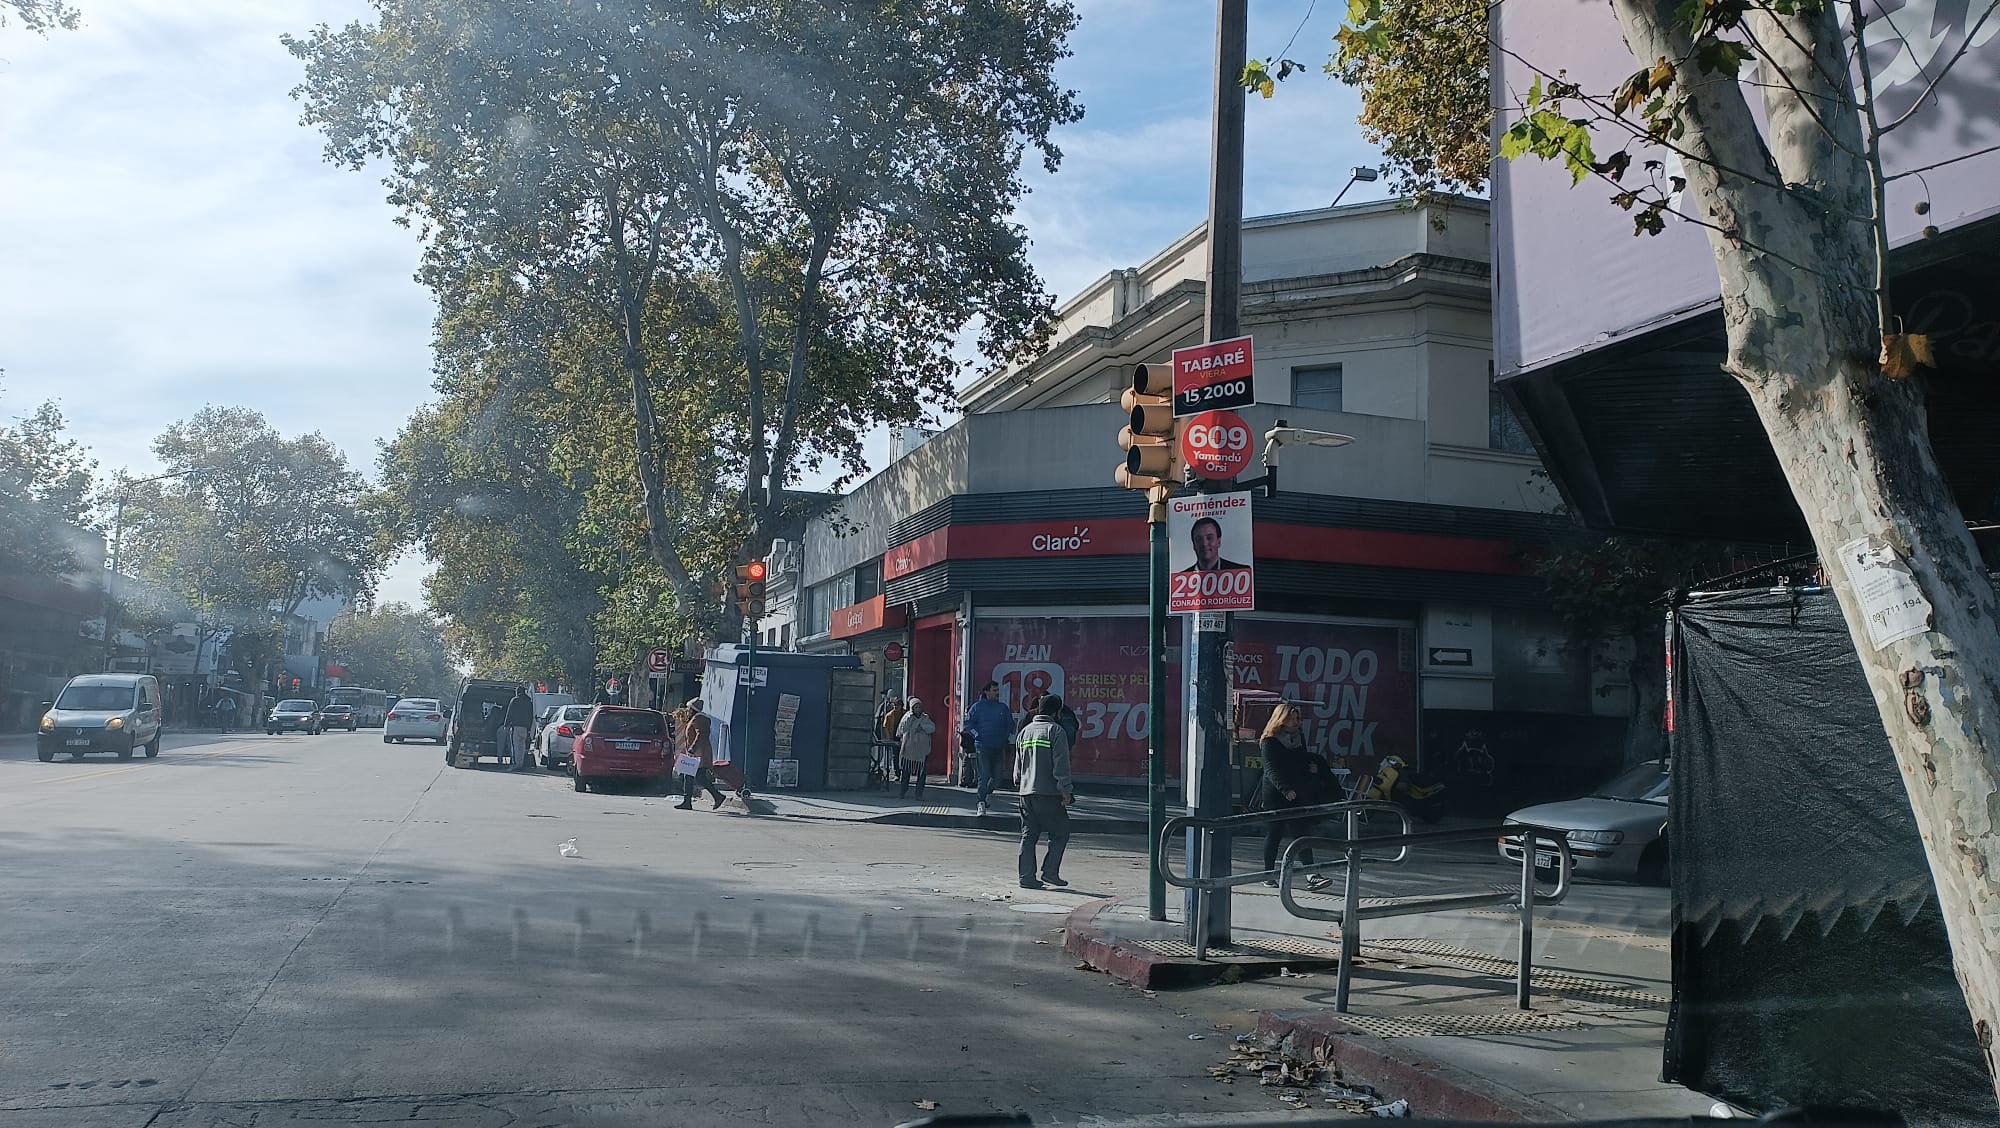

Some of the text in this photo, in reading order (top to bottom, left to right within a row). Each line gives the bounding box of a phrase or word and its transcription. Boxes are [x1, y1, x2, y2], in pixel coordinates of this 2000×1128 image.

[1182, 348, 1245, 373] TABARÉ
[1200, 368, 1226, 379] VIERA
[1183, 380, 1246, 403] 15 2000
[1188, 424, 1248, 450] 609
[1193, 450, 1242, 462] Yamandú
[1205, 462, 1227, 472] Orsi
[1173, 496, 1246, 513] Gurméndez
[1032, 534, 1081, 552] Claro
[1171, 571, 1250, 598] 29000
[1171, 596, 1251, 607] CONRADO RODRÍGUEZ
[1902, 597, 1922, 609] 194
[1004, 644, 1052, 661] PLAN
[1276, 645, 1378, 685] TODO
[1119, 674, 1127, 685] Y
[1129, 674, 1149, 685] PEL
[1234, 666, 1262, 685] YA
[1002, 670, 1053, 714] 18
[1313, 683, 1369, 720] UN
